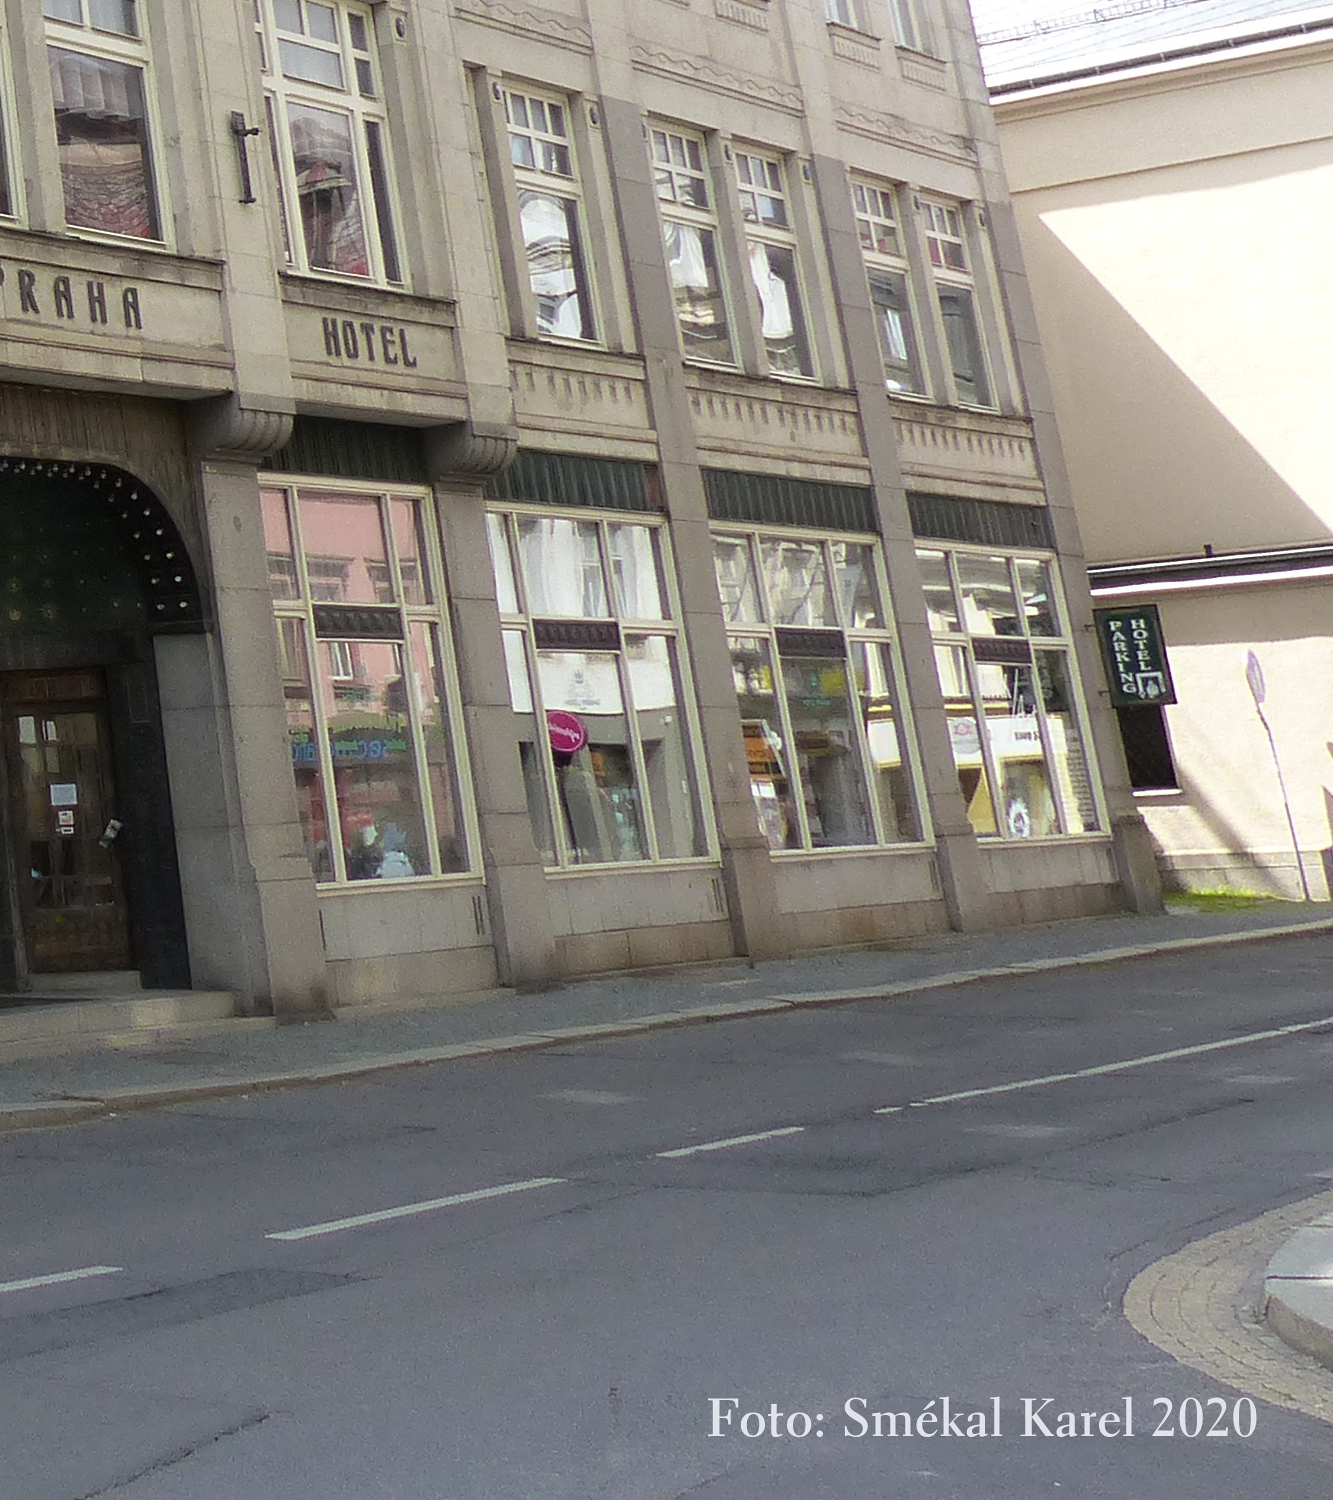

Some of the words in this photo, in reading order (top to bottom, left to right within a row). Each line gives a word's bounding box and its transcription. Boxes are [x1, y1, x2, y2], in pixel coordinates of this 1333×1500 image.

[322, 317, 418, 367] HOTEL
[1108, 620, 1137, 694] PARKING
[1130, 619, 1152, 671] HOTEL
